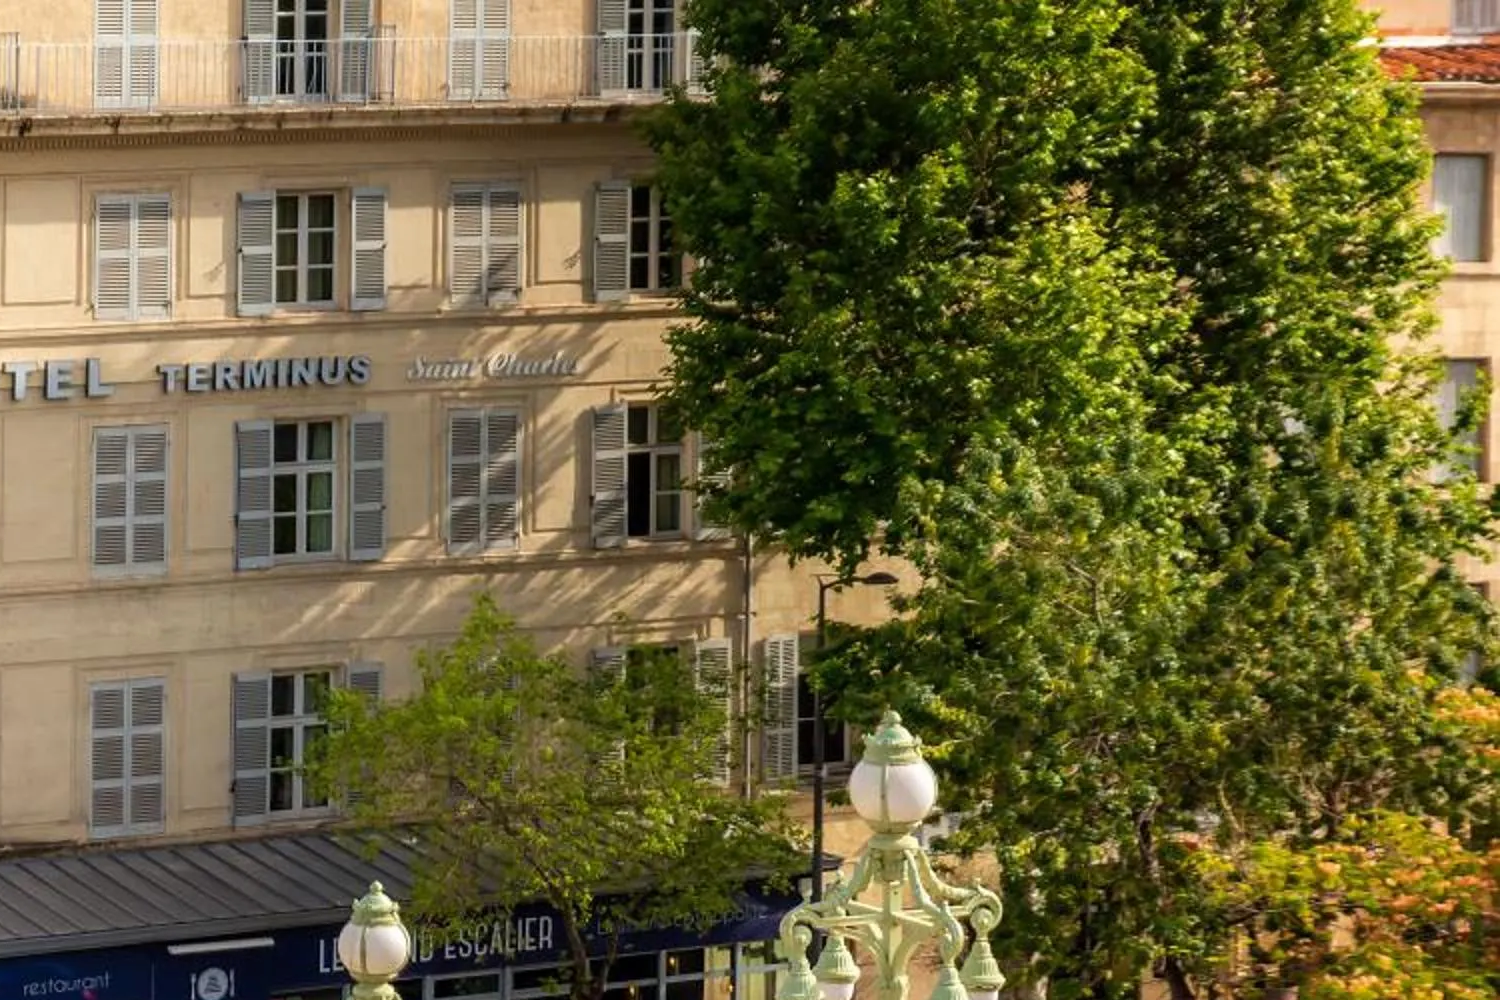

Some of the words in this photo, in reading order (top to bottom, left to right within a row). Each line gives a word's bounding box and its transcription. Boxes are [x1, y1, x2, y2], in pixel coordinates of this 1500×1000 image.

[157, 354, 371, 394] TERMINUS
[444, 915, 554, 959] ESCALIER
[23, 971, 111, 998] restaurant
